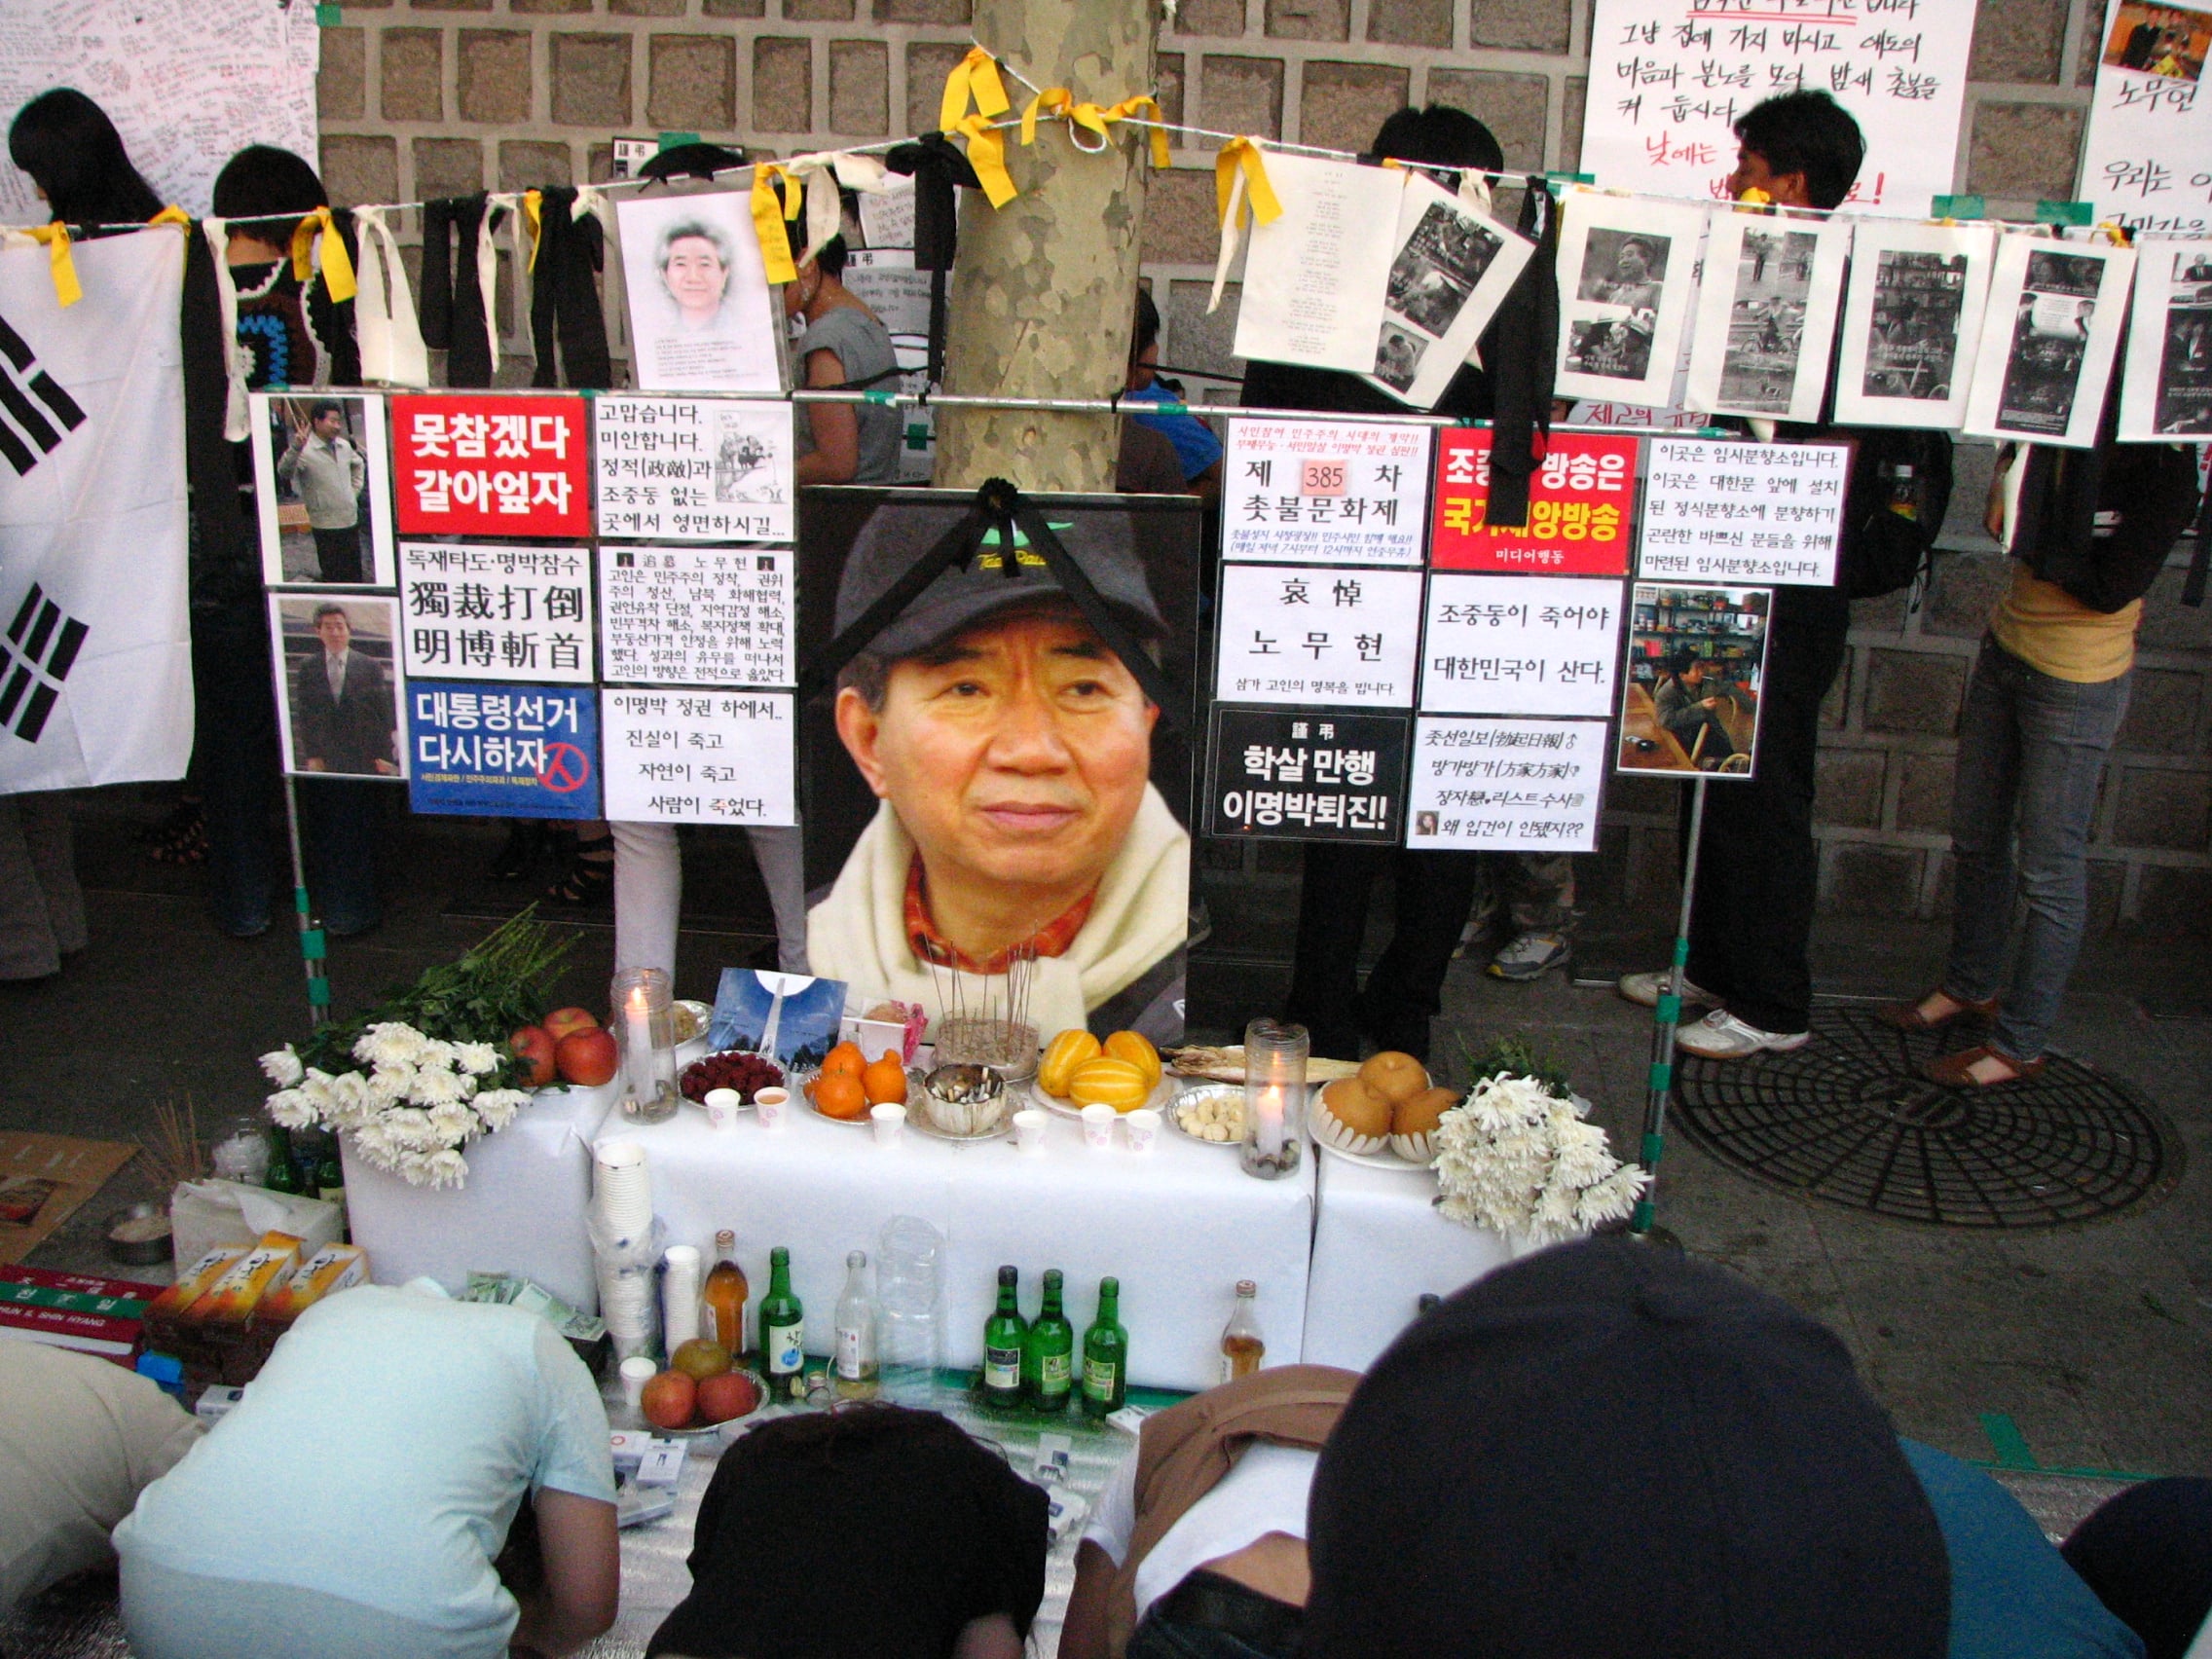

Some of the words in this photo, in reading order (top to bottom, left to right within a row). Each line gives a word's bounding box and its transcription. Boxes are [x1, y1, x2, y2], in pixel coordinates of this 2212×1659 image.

[1729, 25, 1768, 53] 가지
[1783, 23, 1843, 55] 마시고
[1861, 30, 1922, 61] 애도의
[1617, 57, 1683, 90] 마음과
[1692, 58, 1756, 89] 분노를
[1768, 62, 1806, 92] 모아
[1829, 63, 1873, 95] 밤새
[2112, 79, 2198, 113] 노무현
[1645, 129, 1718, 166] 낮에는
[2102, 159, 2173, 198] 우리는
[599, 403, 704, 424] 고맙습니다.
[410, 413, 571, 460] 못참겠다
[601, 431, 705, 453] 미안합니다.
[1659, 444, 1707, 463] 이곳은
[1714, 447, 1840, 469] 임시분향소입니다.
[1245, 460, 1272, 488] 제
[1305, 466, 1344, 489] 385
[1374, 463, 1403, 493] 차
[1540, 453, 1626, 492] 방송은
[1652, 472, 1699, 491] 이곳은
[1709, 474, 1757, 493] 대한문
[1767, 476, 1798, 495] 앞에
[1809, 479, 1839, 496] 설치
[414, 469, 572, 515] 갈아엎자
[602, 486, 661, 506] 조중동
[670, 486, 709, 507] 없는
[1242, 495, 1400, 527] 촛불문화제
[1648, 500, 1665, 516] 된
[1674, 501, 1767, 521] 정식분향소에
[1773, 506, 1836, 524] 분향하기
[602, 512, 662, 533] 곳에서
[673, 513, 786, 537] 영면하시길...
[1646, 528, 1692, 545] 곤란한
[1750, 533, 1797, 549] 분들을
[1801, 535, 1832, 551] 위해
[406, 548, 583, 576] 독재타도·명박참수
[1495, 547, 1565, 565] 미디어행동
[1644, 556, 1689, 572] 마련된
[1696, 559, 1822, 577] 임시분향소입니다.
[608, 570, 647, 584] 고인은
[653, 571, 705, 585] 민주주의
[757, 573, 784, 588] 권위
[408, 580, 584, 623] 獨裁打倒
[608, 586, 635, 600] 주의
[1437, 604, 1528, 628] 조중동이
[1539, 606, 1610, 631] 죽어야
[413, 628, 585, 671] 明博斬首
[680, 635, 719, 649] 안정을
[725, 637, 752, 649] 위해
[758, 637, 785, 651] 노력
[648, 649, 687, 664] 성과의
[744, 653, 785, 667] 떠나서
[1433, 656, 1545, 682] 대한민국이
[1558, 660, 1605, 684] 산다.
[611, 665, 647, 678] 고인의
[652, 666, 690, 680] 방향은
[694, 667, 741, 681] 전적으로
[1266, 679, 1305, 693] 고인의
[1354, 682, 1396, 697] 빕니다.
[416, 692, 579, 733] 대통령선거
[613, 696, 669, 717] 이명박
[677, 698, 712, 718] 정권
[625, 728, 680, 750] 진실이
[687, 731, 725, 750] 죽고
[419, 733, 549, 774] 다시하자
[1243, 745, 1309, 783] 학살
[1313, 749, 1377, 787] 만행
[638, 763, 691, 783] 자연이
[700, 764, 737, 784] 죽고
[647, 794, 700, 815] 사람이
[708, 797, 767, 819] 죽었다.
[1223, 790, 1387, 830] 이명박퇴진!
[1441, 819, 1460, 835] 왜
[1466, 820, 1513, 838] 입건이
[66, 1315, 106, 1327] HYANG
